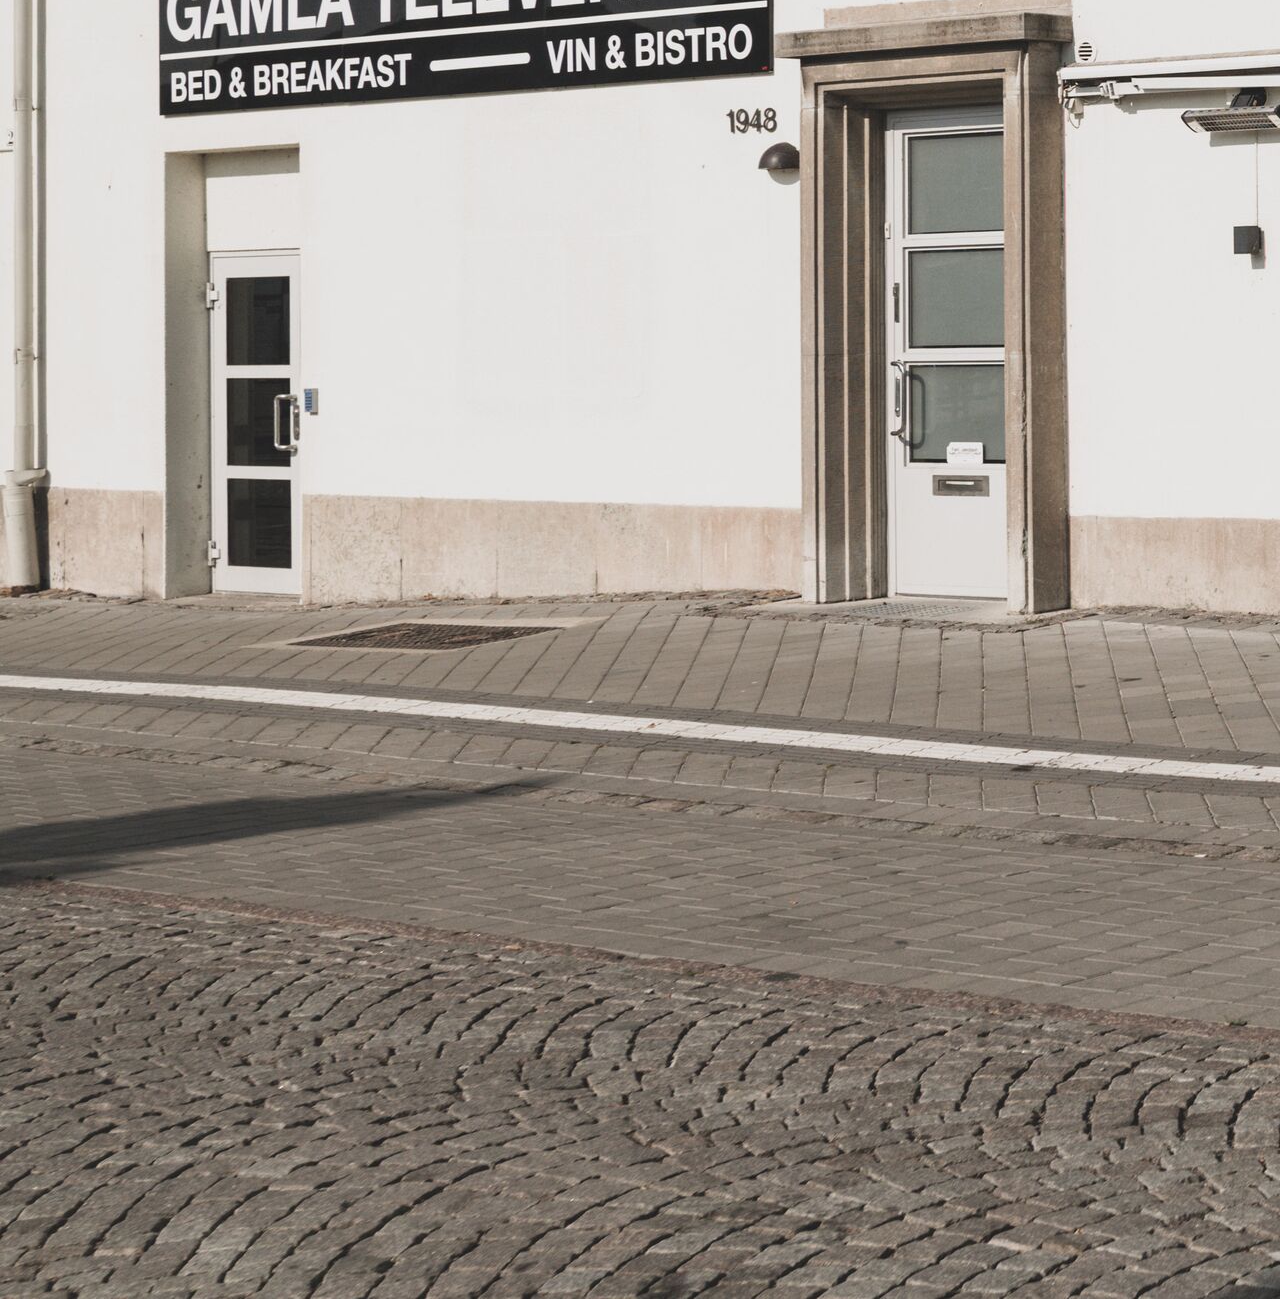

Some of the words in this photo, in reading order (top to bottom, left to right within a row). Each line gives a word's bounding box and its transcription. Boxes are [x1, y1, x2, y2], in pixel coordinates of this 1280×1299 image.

[546, 36, 597, 74] VIN
[604, 34, 627, 70] &
[635, 22, 753, 68] BISTRO
[170, 68, 222, 103] BED
[228, 66, 248, 99] &
[253, 52, 413, 97] BREAKFAST
[726, 107, 777, 134] 1948
